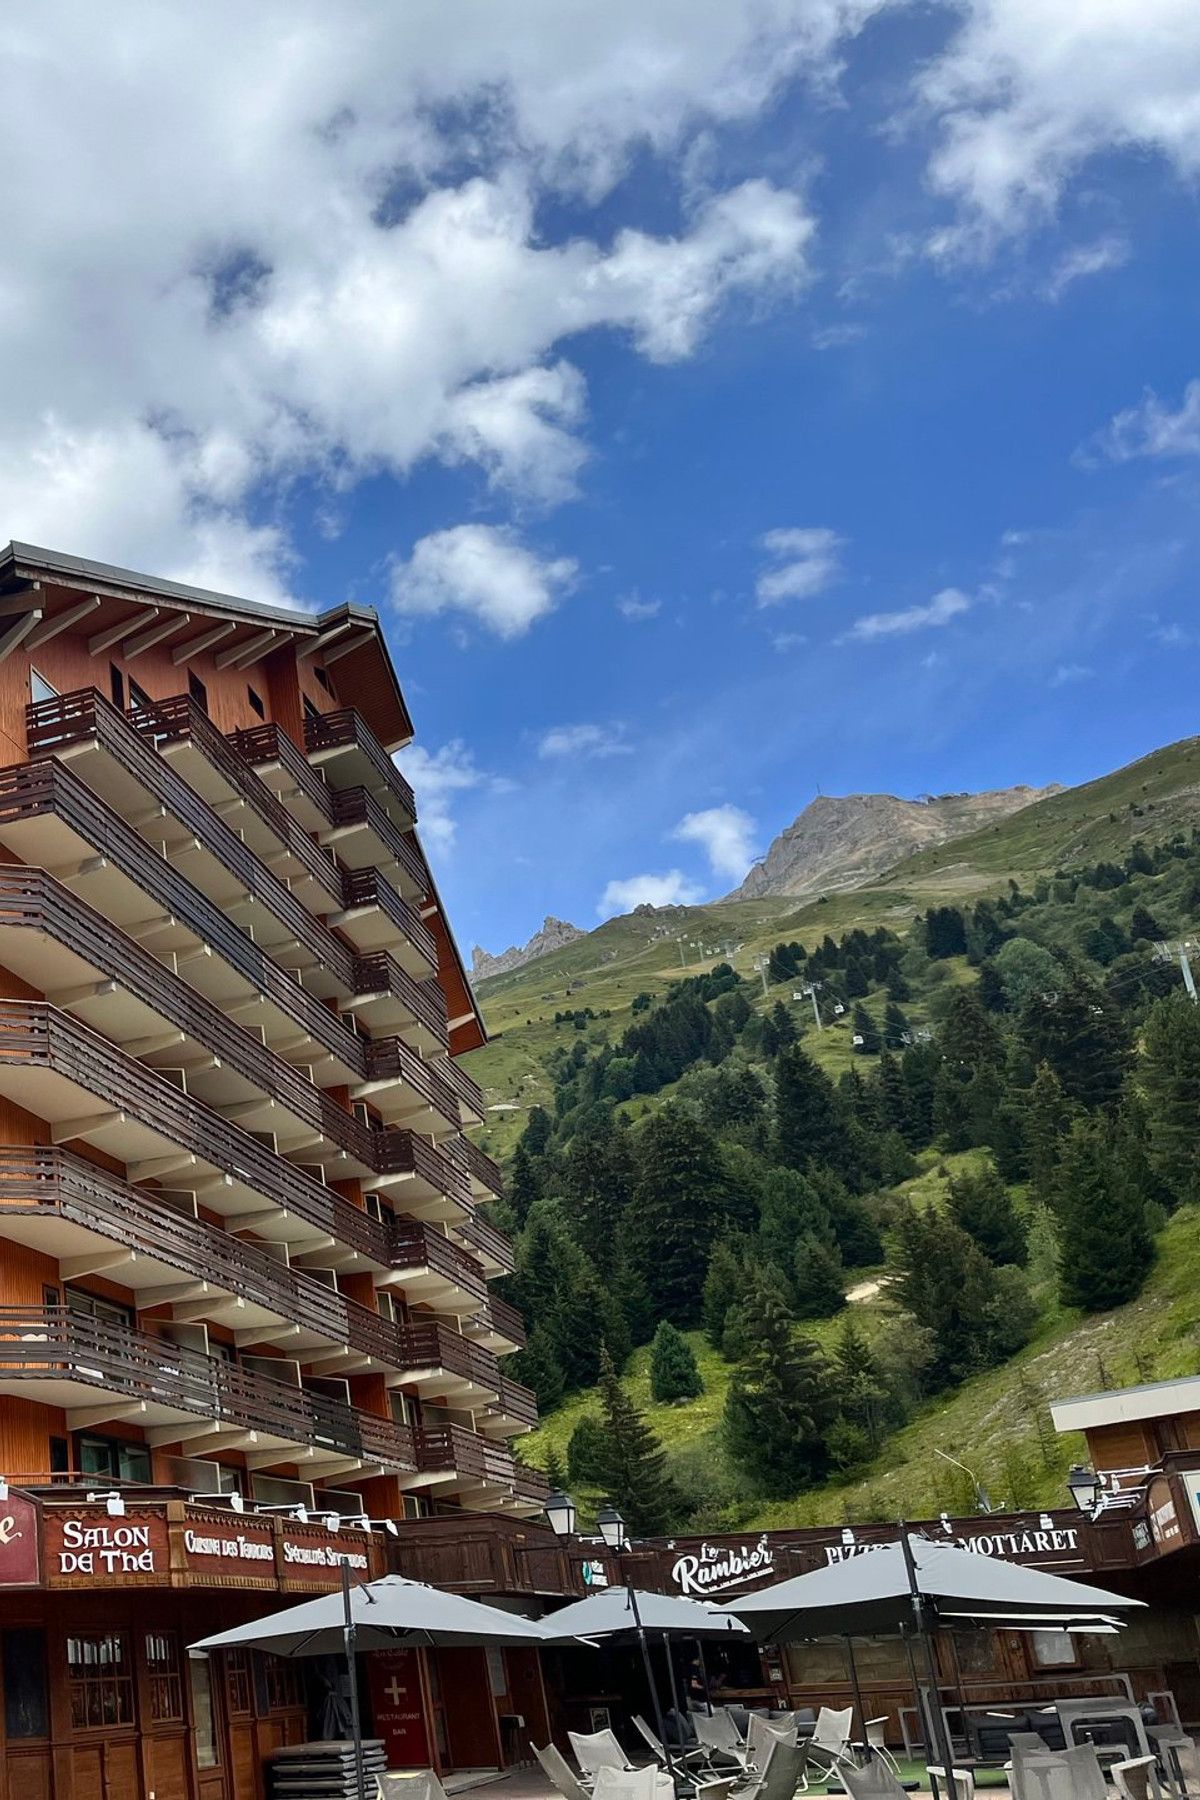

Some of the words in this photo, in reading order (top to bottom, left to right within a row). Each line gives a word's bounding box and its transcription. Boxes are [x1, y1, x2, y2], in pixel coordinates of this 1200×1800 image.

[63, 1521, 150, 1549] SALON
[957, 1529, 1078, 1556] MOTTARET
[58, 1552, 94, 1574] DE
[699, 1543, 719, 1562] Le
